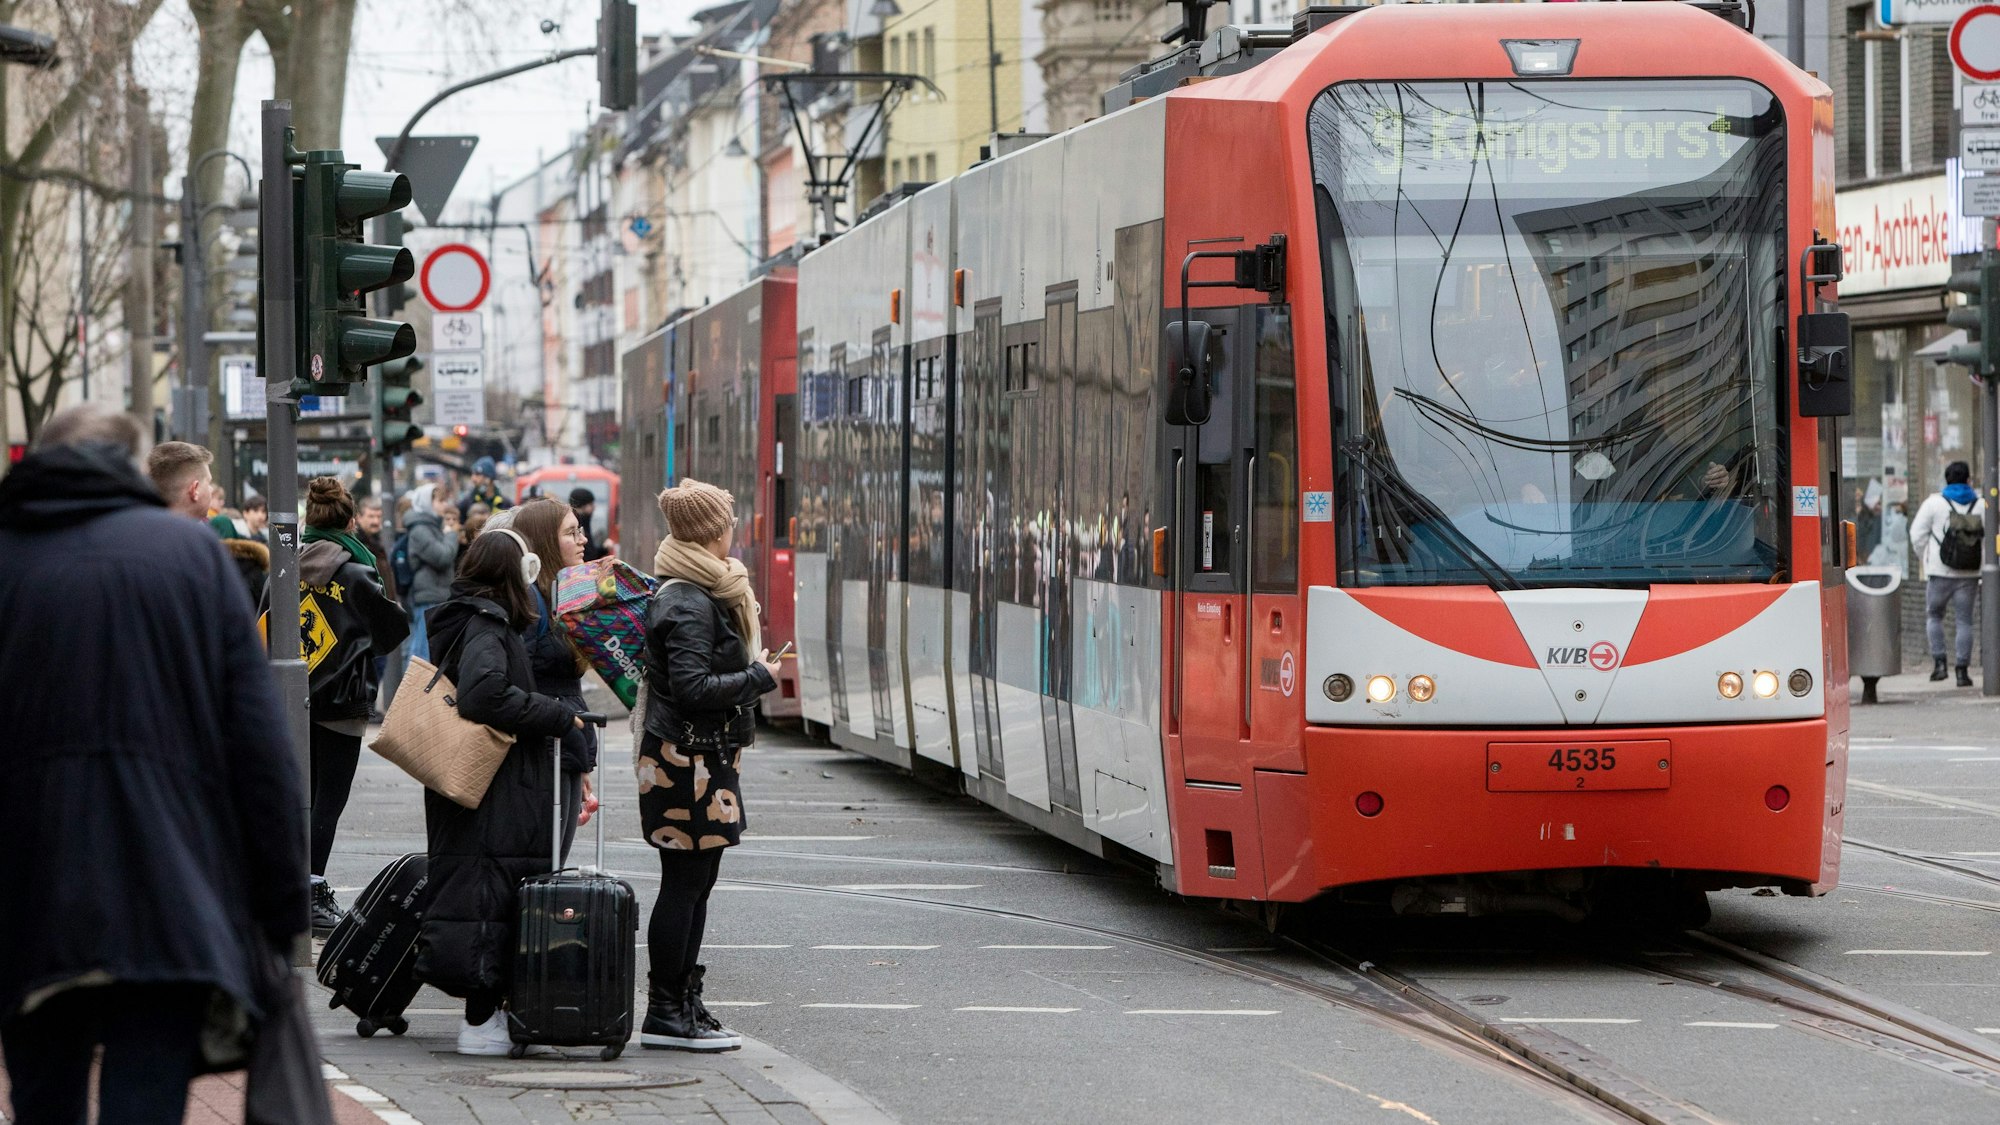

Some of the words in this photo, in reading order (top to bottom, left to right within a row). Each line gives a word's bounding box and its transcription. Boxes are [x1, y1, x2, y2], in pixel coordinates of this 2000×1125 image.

[1981, 111, 1999, 119] frei
[1375, 107, 1403, 175] 9
[1981, 157, 1999, 165] frei
[1546, 647, 1588, 664] KVB
[1548, 747, 1616, 771] 4535
[1576, 777, 1584, 788] 2
[356, 921, 396, 975] TRAVELLER
